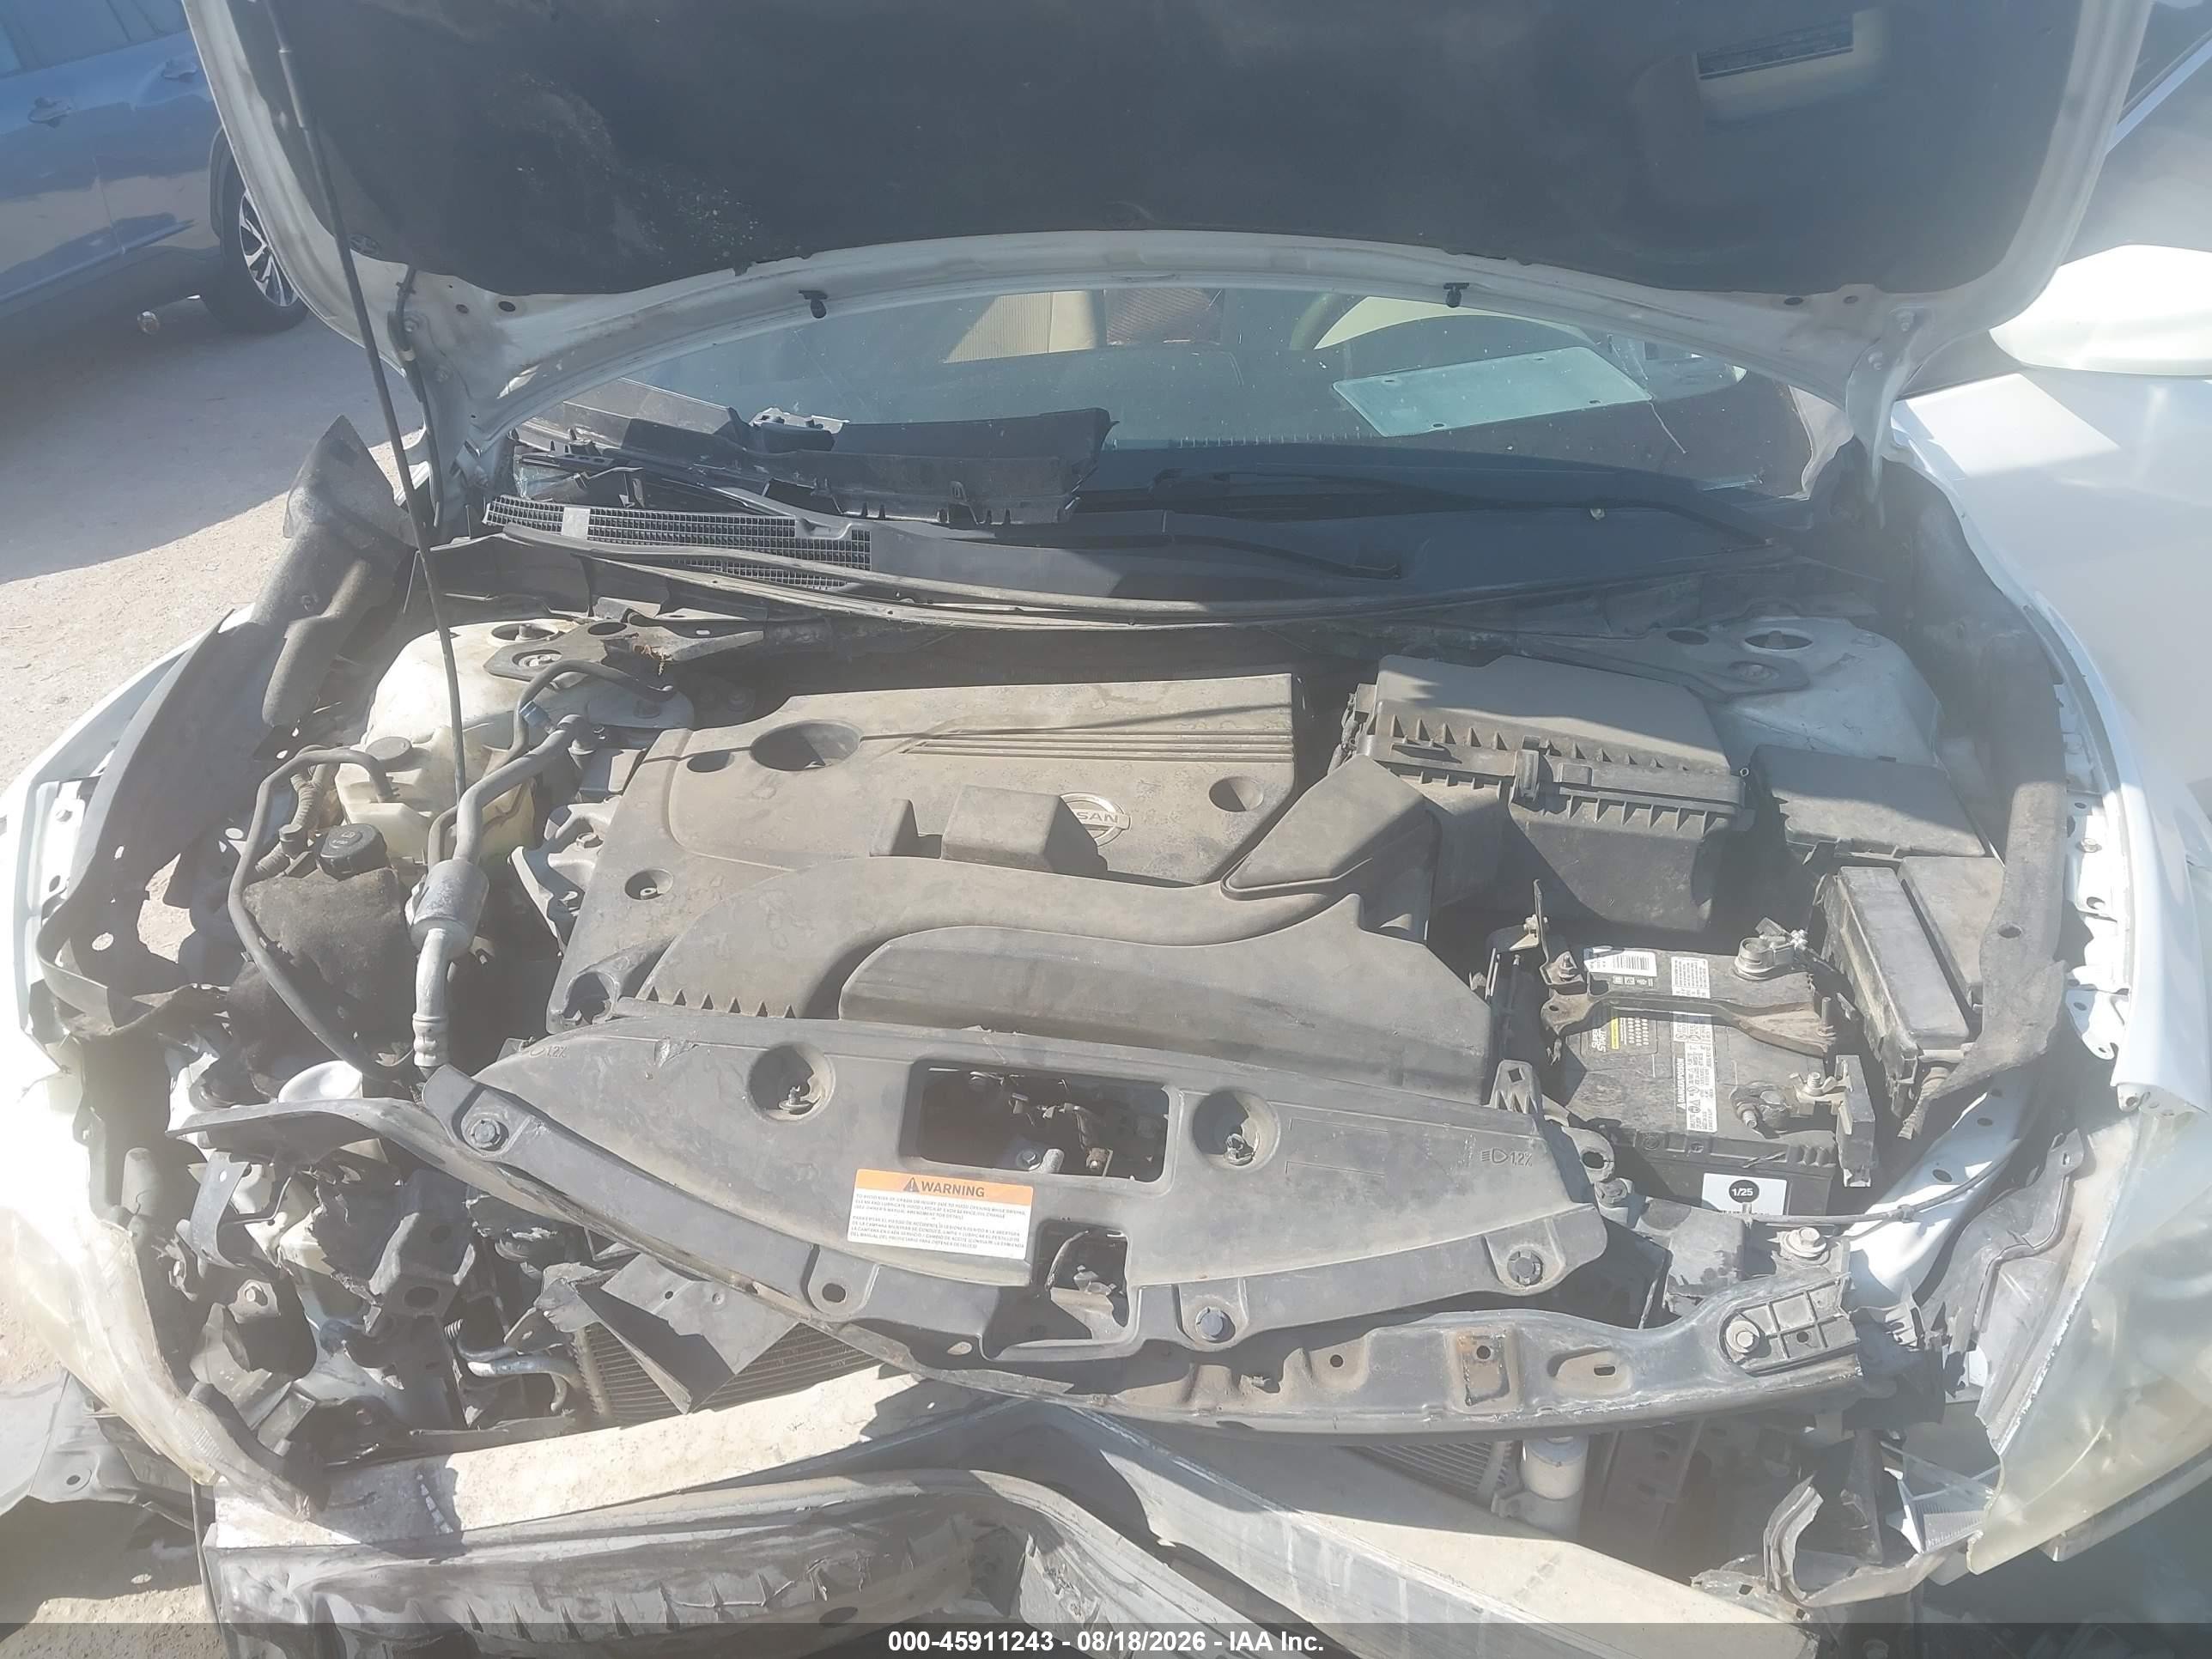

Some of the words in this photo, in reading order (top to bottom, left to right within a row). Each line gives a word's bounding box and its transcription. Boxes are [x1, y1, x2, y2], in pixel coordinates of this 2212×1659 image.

[1076, 811, 1119, 823] SAN
[1597, 1030, 1607, 1053] START
[921, 1181, 985, 1198] WARNING
[1731, 1188, 1753, 1197] 1/25
